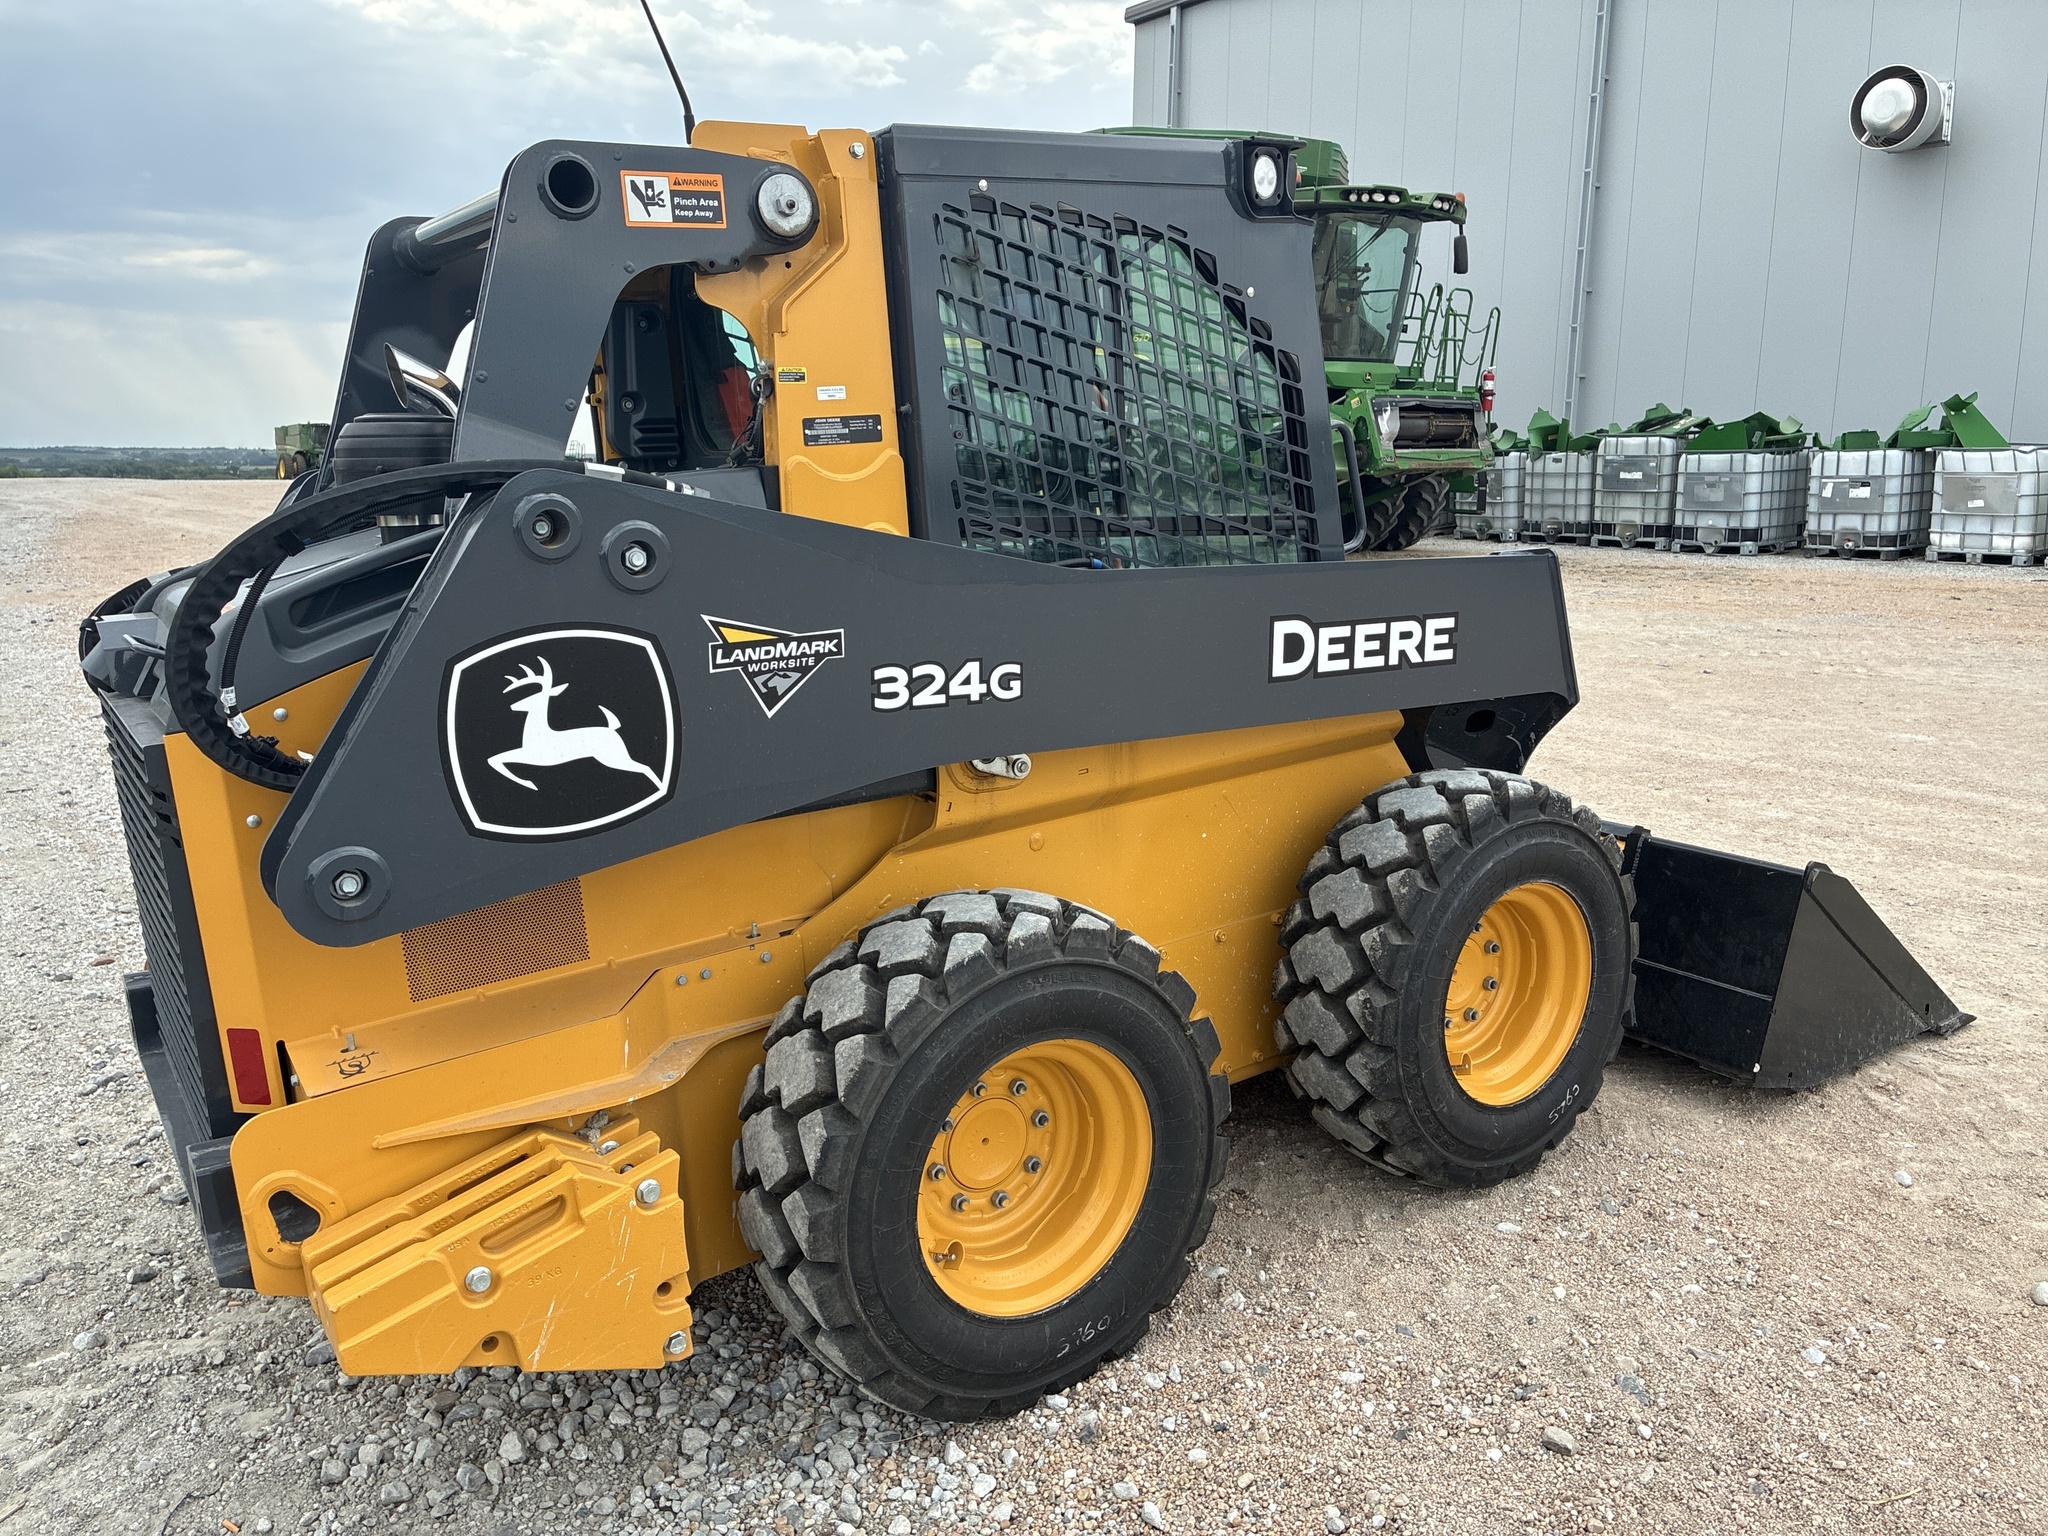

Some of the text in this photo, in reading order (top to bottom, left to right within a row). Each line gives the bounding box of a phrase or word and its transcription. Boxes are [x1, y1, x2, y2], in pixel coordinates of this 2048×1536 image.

[681, 178, 719, 188] WARNING
[674, 197, 719, 207] Pinch Area
[675, 208, 713, 219] Keep Away
[1133, 333, 1150, 342] 670
[715, 639, 839, 665] LANDMARK
[1271, 616, 1456, 678] DEERE
[747, 656, 816, 674] WORKSITE
[872, 660, 1022, 710] 324G
